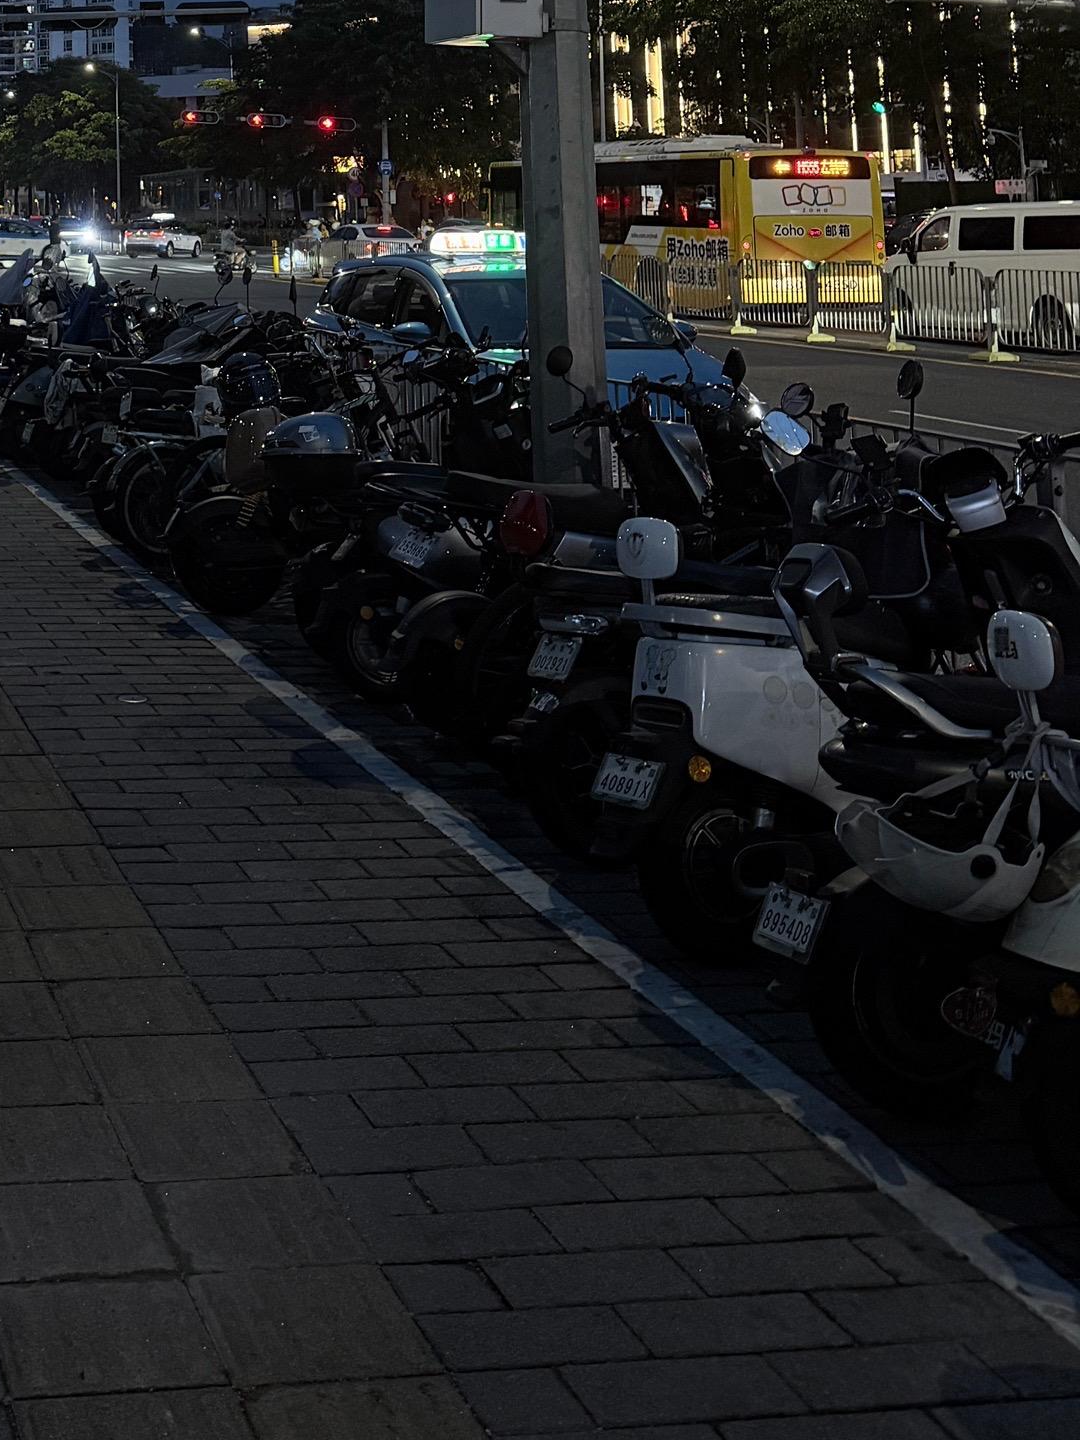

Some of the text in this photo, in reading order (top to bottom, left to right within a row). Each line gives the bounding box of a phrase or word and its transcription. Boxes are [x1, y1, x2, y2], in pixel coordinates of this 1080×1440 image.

[774, 223, 850, 237] Zoho 邮箱
[667, 237, 728, 262] 用Zoho邮箱
[600, 773, 651, 798] 40891X
